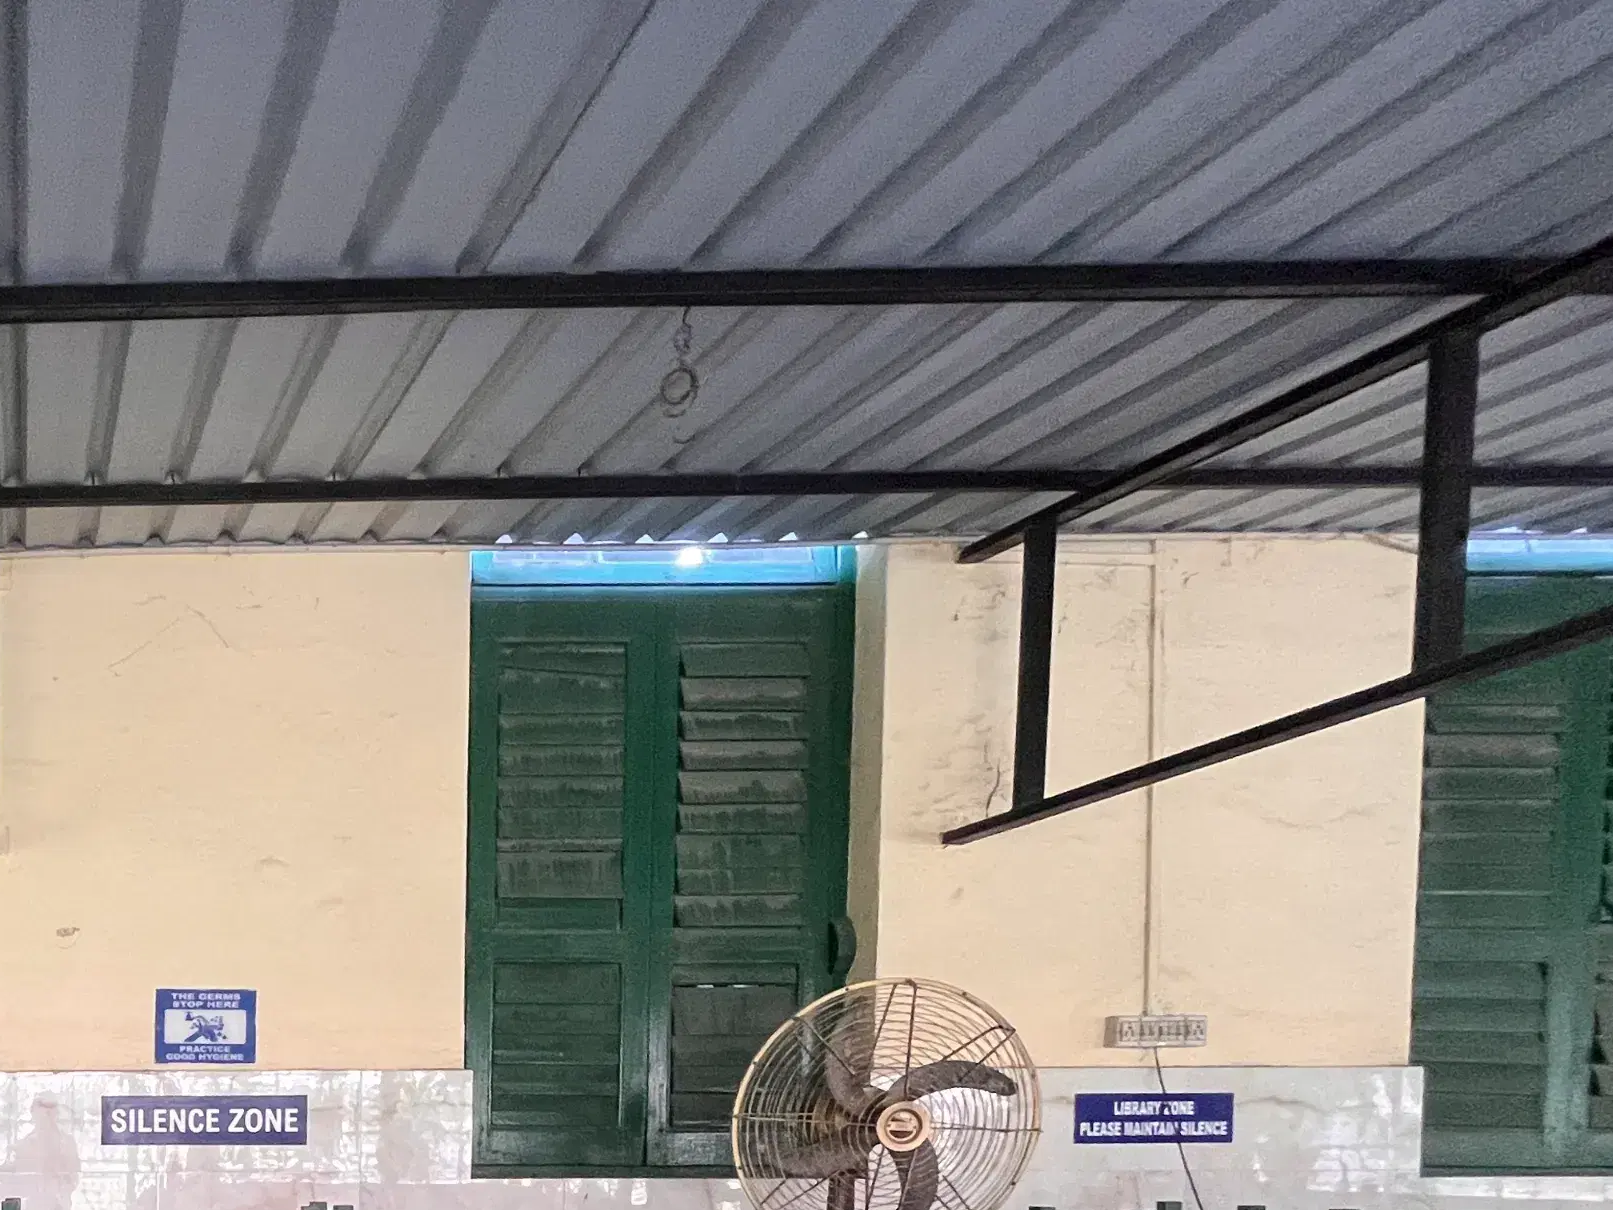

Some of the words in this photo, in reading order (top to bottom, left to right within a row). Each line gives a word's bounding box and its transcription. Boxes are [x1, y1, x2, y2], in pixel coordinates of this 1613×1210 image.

[171, 992, 195, 1000] THE
[179, 1045, 231, 1053] PRACTICE
[198, 1053, 244, 1061] HYGIENE
[1113, 1101, 1161, 1115] LIBRARY
[111, 1108, 220, 1133] SILENCE
[227, 1108, 299, 1133] ZONE
[1079, 1122, 1122, 1136] PLEASE
[1180, 1121, 1228, 1136] SILENCE
